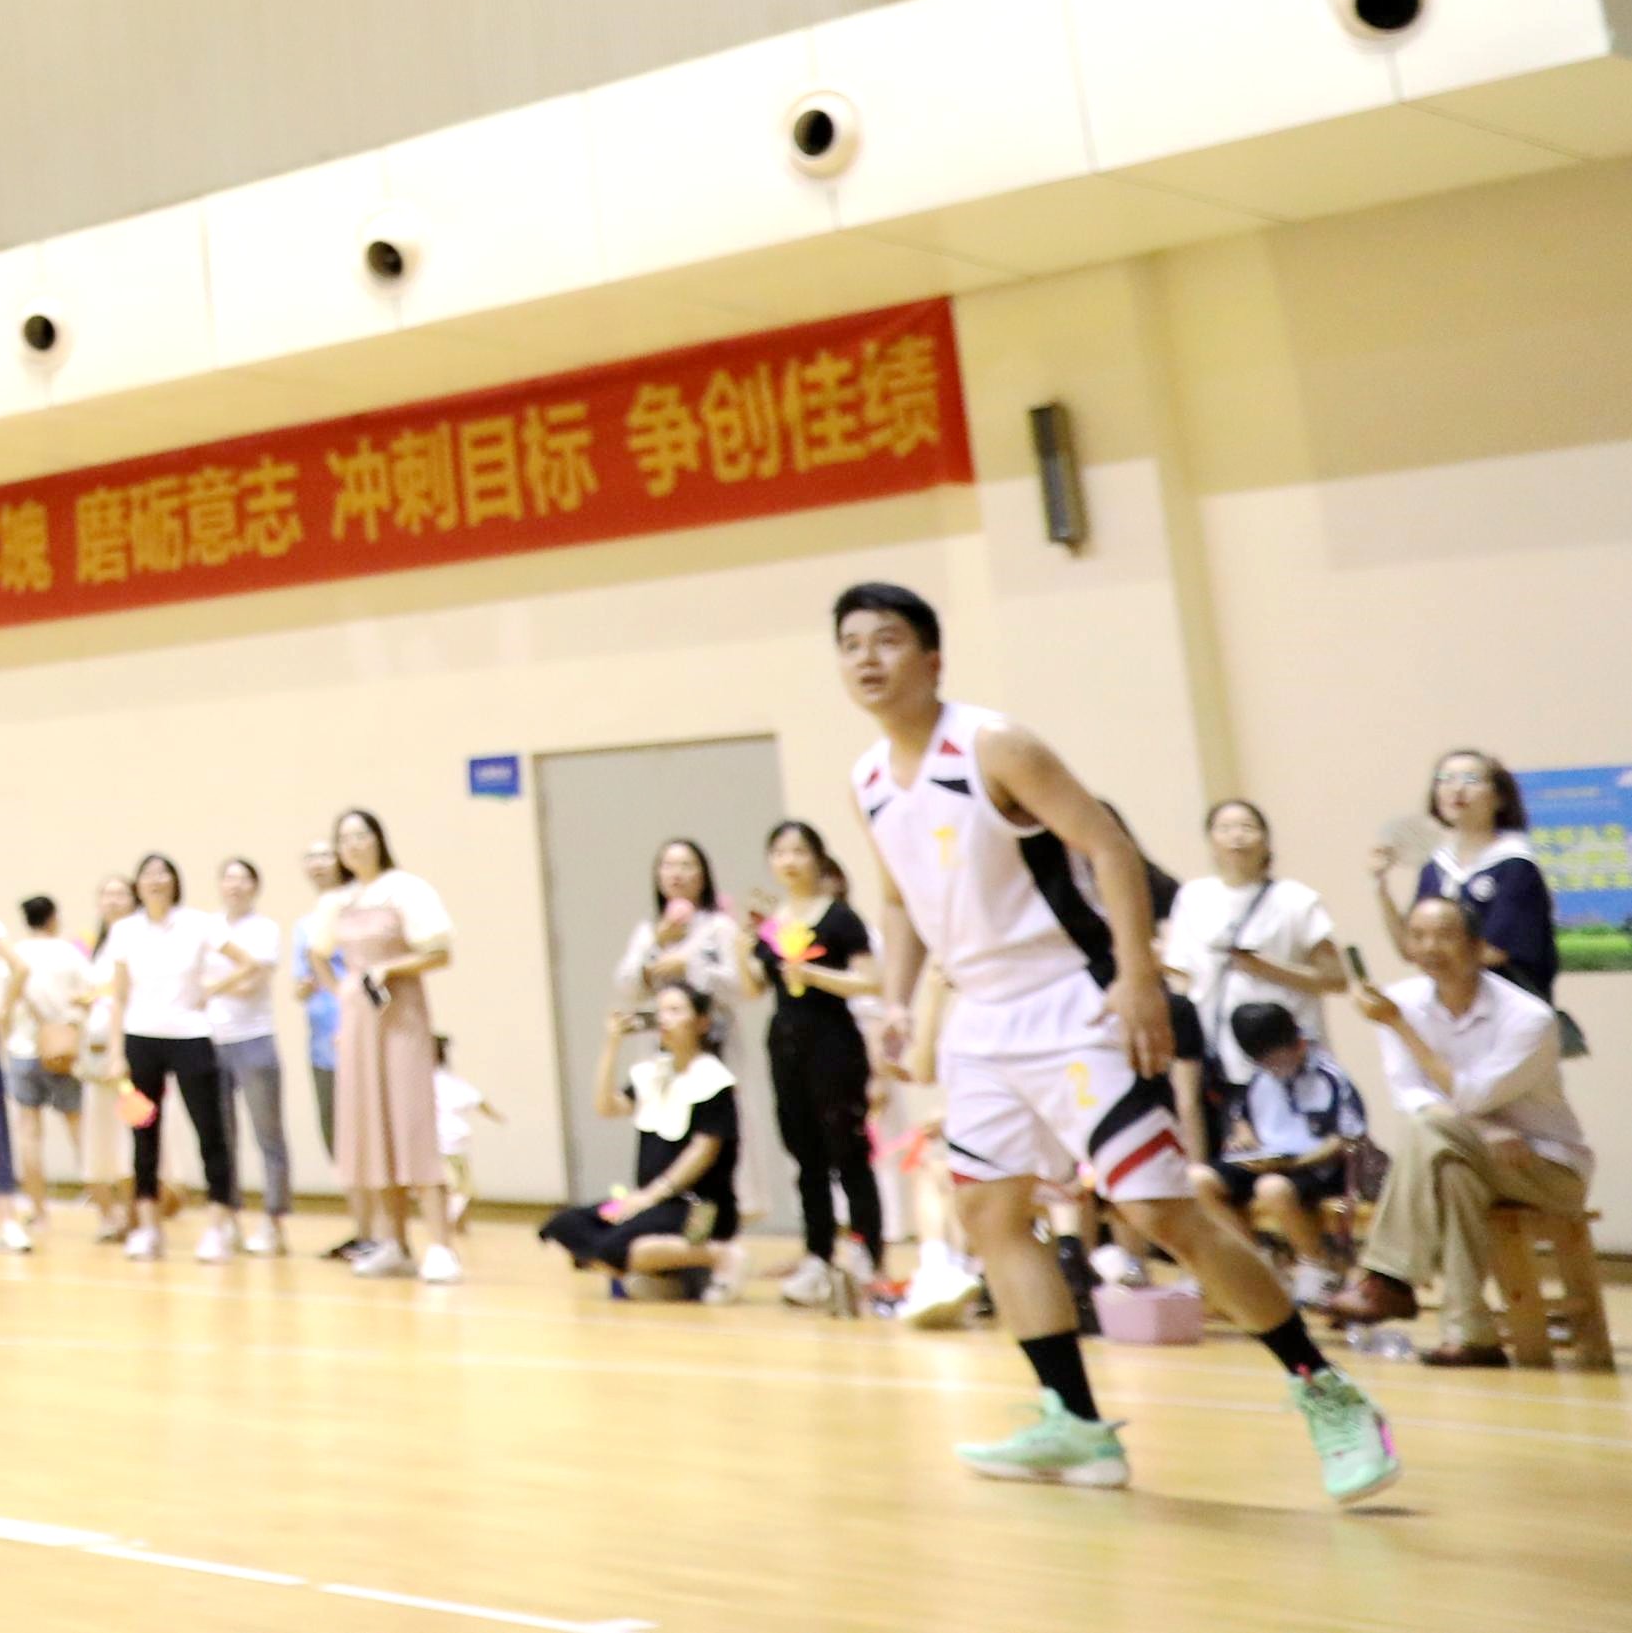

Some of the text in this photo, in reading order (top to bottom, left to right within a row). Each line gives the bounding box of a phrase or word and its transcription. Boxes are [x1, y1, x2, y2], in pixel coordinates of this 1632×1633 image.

[74, 456, 302, 585] 磨砺意志
[327, 400, 598, 544] 冲刺目标
[625, 334, 942, 499] 争创佳绩
